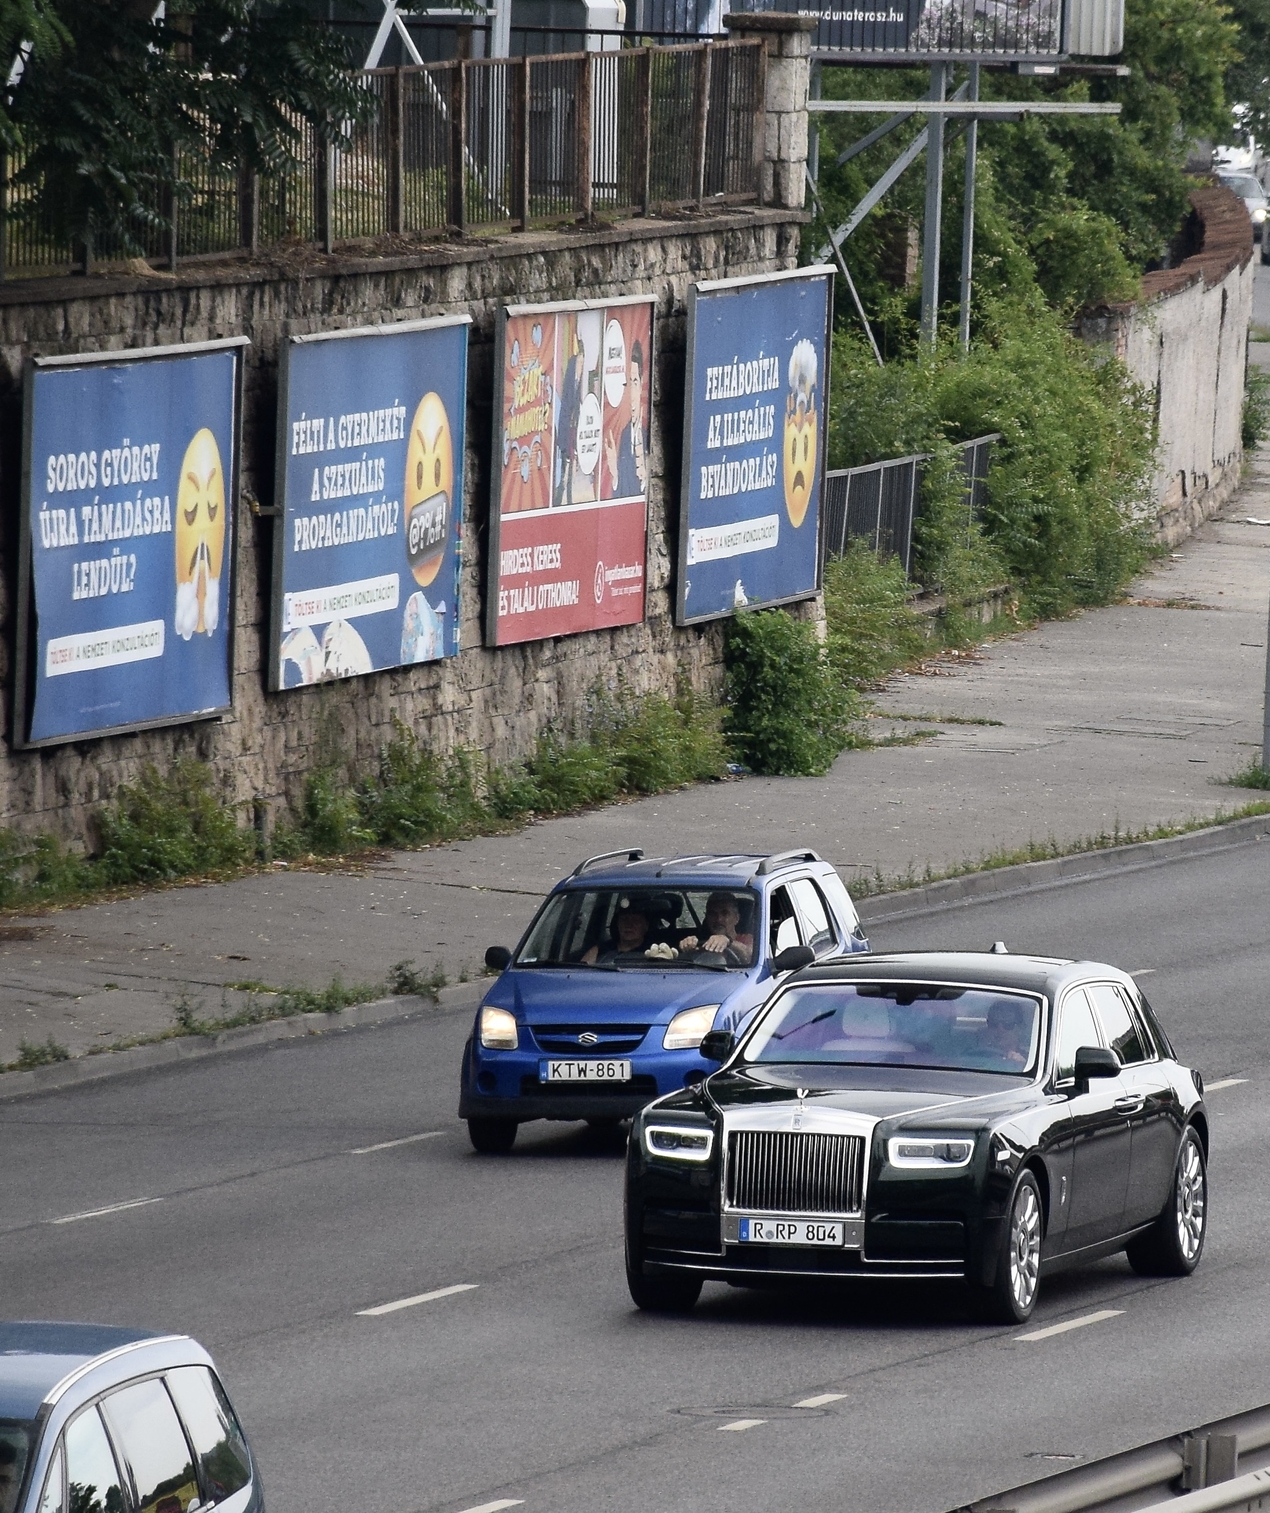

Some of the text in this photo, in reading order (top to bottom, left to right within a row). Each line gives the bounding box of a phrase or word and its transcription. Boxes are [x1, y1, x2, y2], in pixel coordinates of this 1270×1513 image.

[705, 351, 780, 401] FELHÁBORÍTJA
[291, 398, 406, 455] FÉLTI A GYERMEKÉT
[707, 399, 775, 449] AZ ILLEGÁLIS
[47, 438, 160, 493] SOROS GYÖRGY
[311, 452, 385, 501] A SZEXUÁLIS
[700, 447, 777, 500] BEVÁNDORLÁS?
[39, 489, 172, 549] ÚJRA TÁMADÁSBA
[294, 495, 400, 552] PROPAGANDÁTÓL?
[72, 547, 137, 601] LENDÜL?
[498, 585, 508, 616] ÉS
[509, 581, 537, 615] TALÁLJ
[538, 579, 580, 610] OTTHONRA!
[552, 1062, 625, 1078] KTW-861
[805, 1224, 837, 1242] 804
